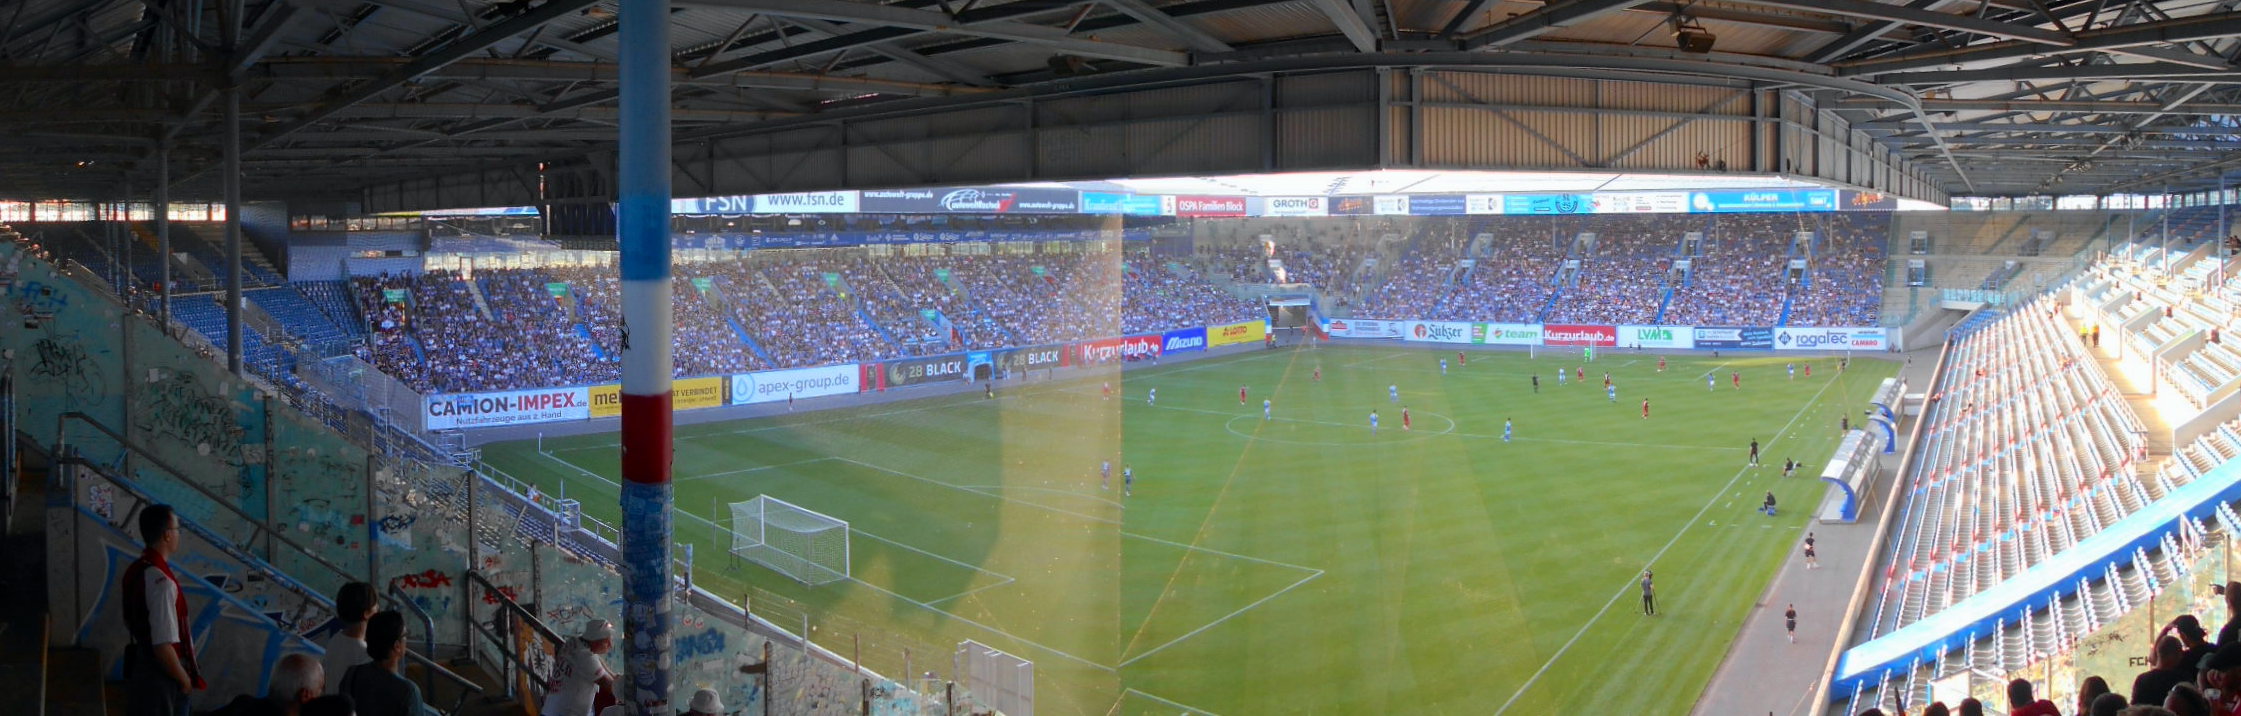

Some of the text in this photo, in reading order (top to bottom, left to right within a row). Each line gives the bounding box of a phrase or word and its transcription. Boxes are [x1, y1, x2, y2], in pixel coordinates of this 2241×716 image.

[768, 193, 845, 206] www.fsn.de
[1273, 199, 1308, 208] GROTH
[1428, 324, 1464, 340] Lübzer
[1505, 329, 1538, 339] team
[1544, 329, 1615, 342] Kurzurlaub.de
[1638, 329, 1661, 340] LVM
[1796, 330, 1848, 347] rogatec
[1028, 350, 1059, 364] BLACK
[908, 361, 962, 377] 28 BLACK
[758, 374, 850, 395] apex-group.de
[681, 387, 717, 397] VERBINDET
[456, 415, 517, 426] Nutzfahrzeuge
[541, 410, 562, 420] Hand
